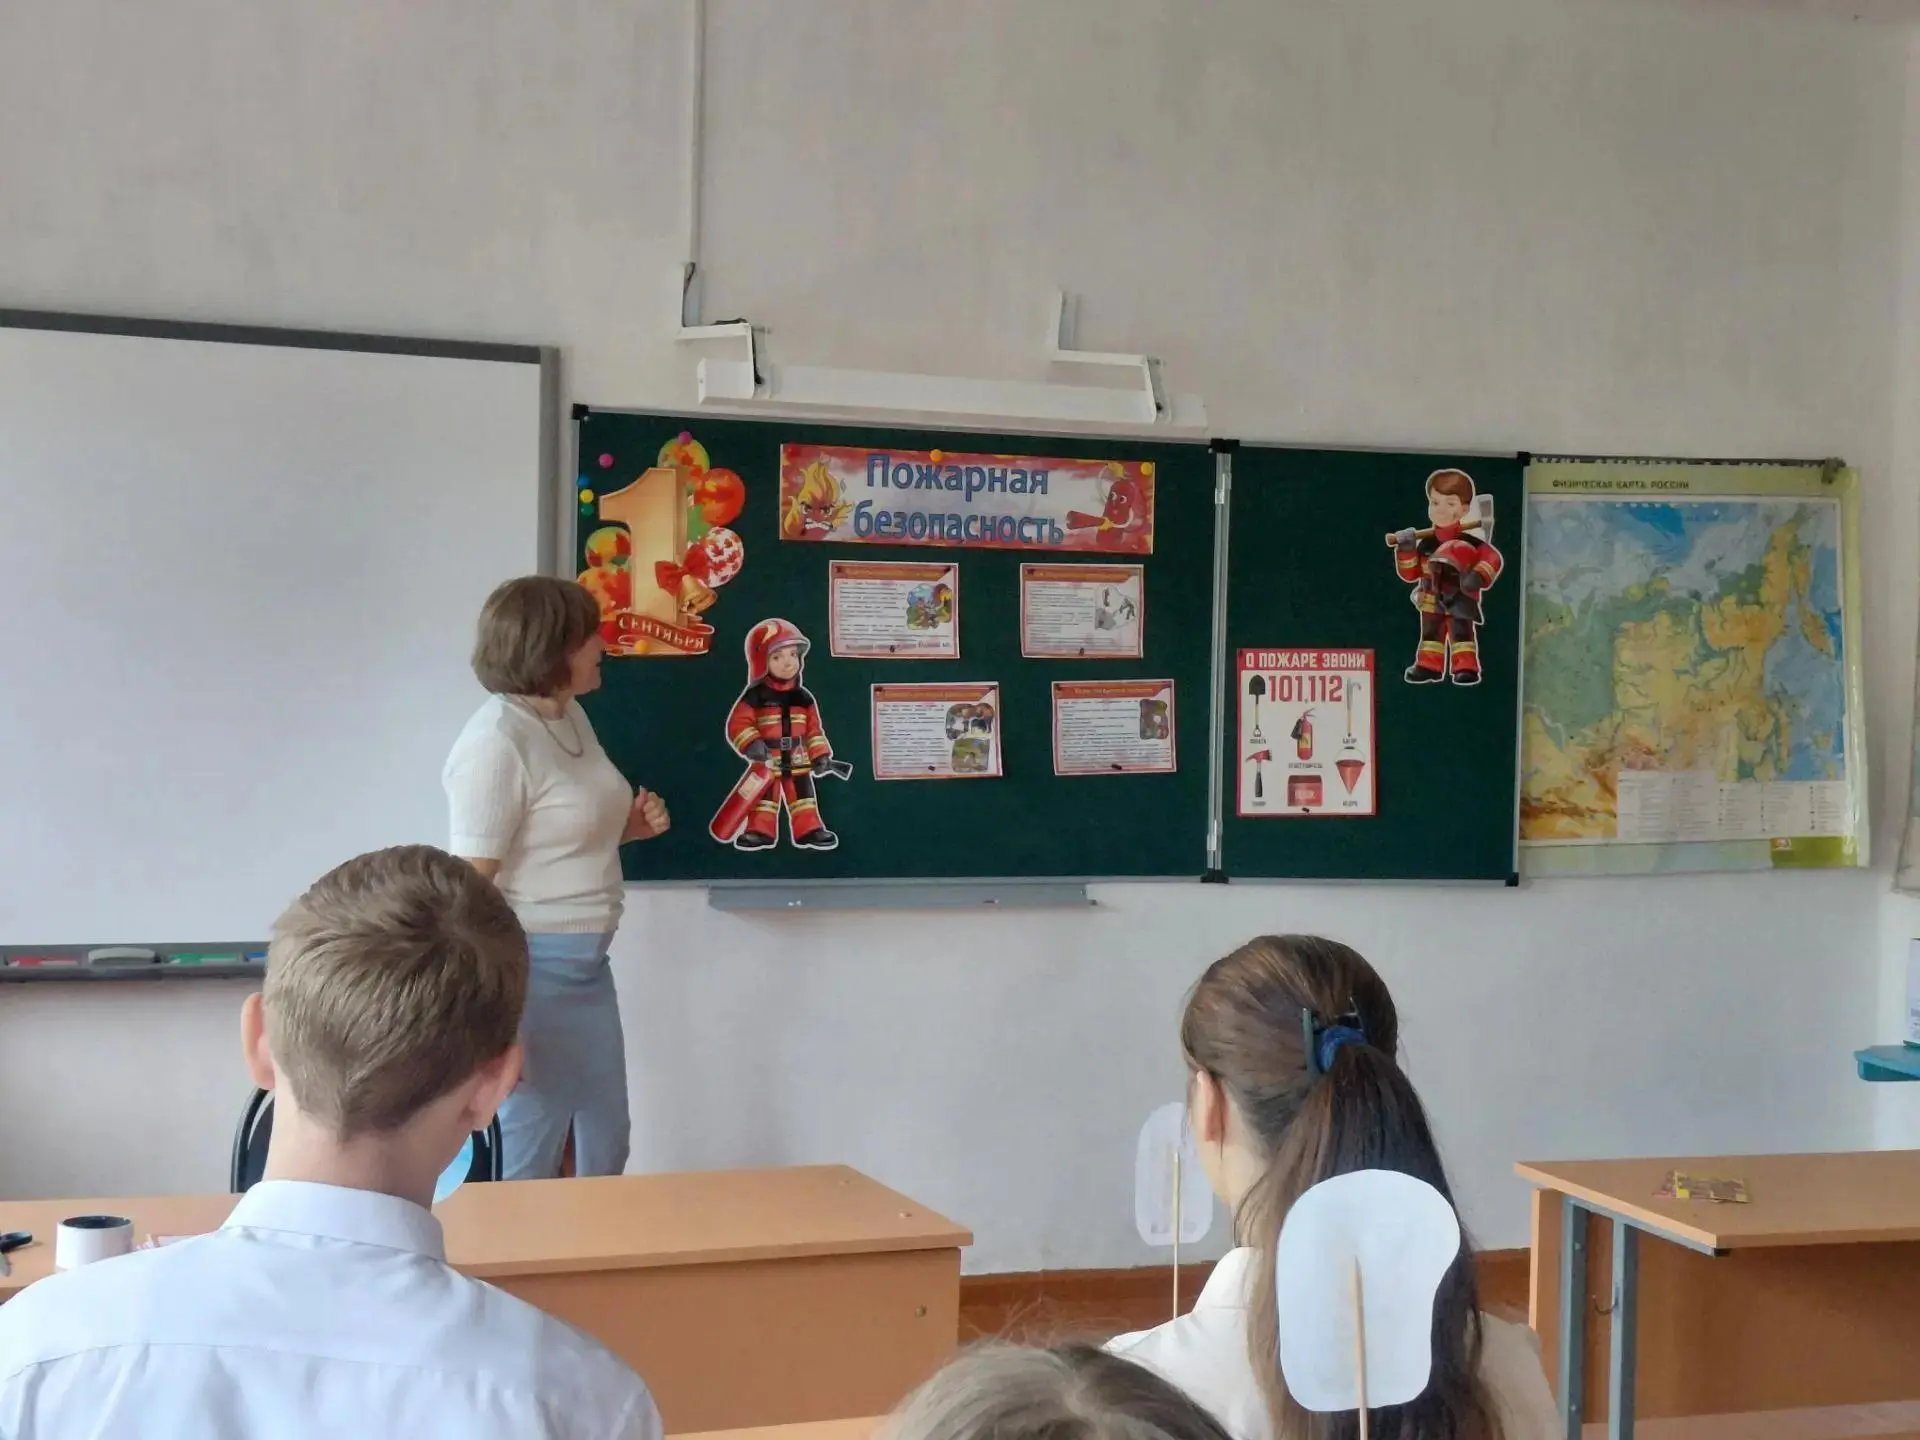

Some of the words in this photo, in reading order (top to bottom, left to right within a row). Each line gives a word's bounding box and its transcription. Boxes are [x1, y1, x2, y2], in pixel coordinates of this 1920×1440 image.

[866, 454, 1049, 502] Пожарная
[1552, 480, 1613, 489] ФИЗИЧЕСКАЯ
[1616, 480, 1647, 489] КАРТА
[1651, 480, 1689, 489] РОССИИ
[854, 500, 1064, 544] безопасность
[618, 616, 706, 649] СЕНТЯБРЯ
[1246, 653, 1254, 668] О
[1259, 653, 1318, 668] ПОЖАРЕ
[1322, 653, 1366, 668] ЗВОНИ
